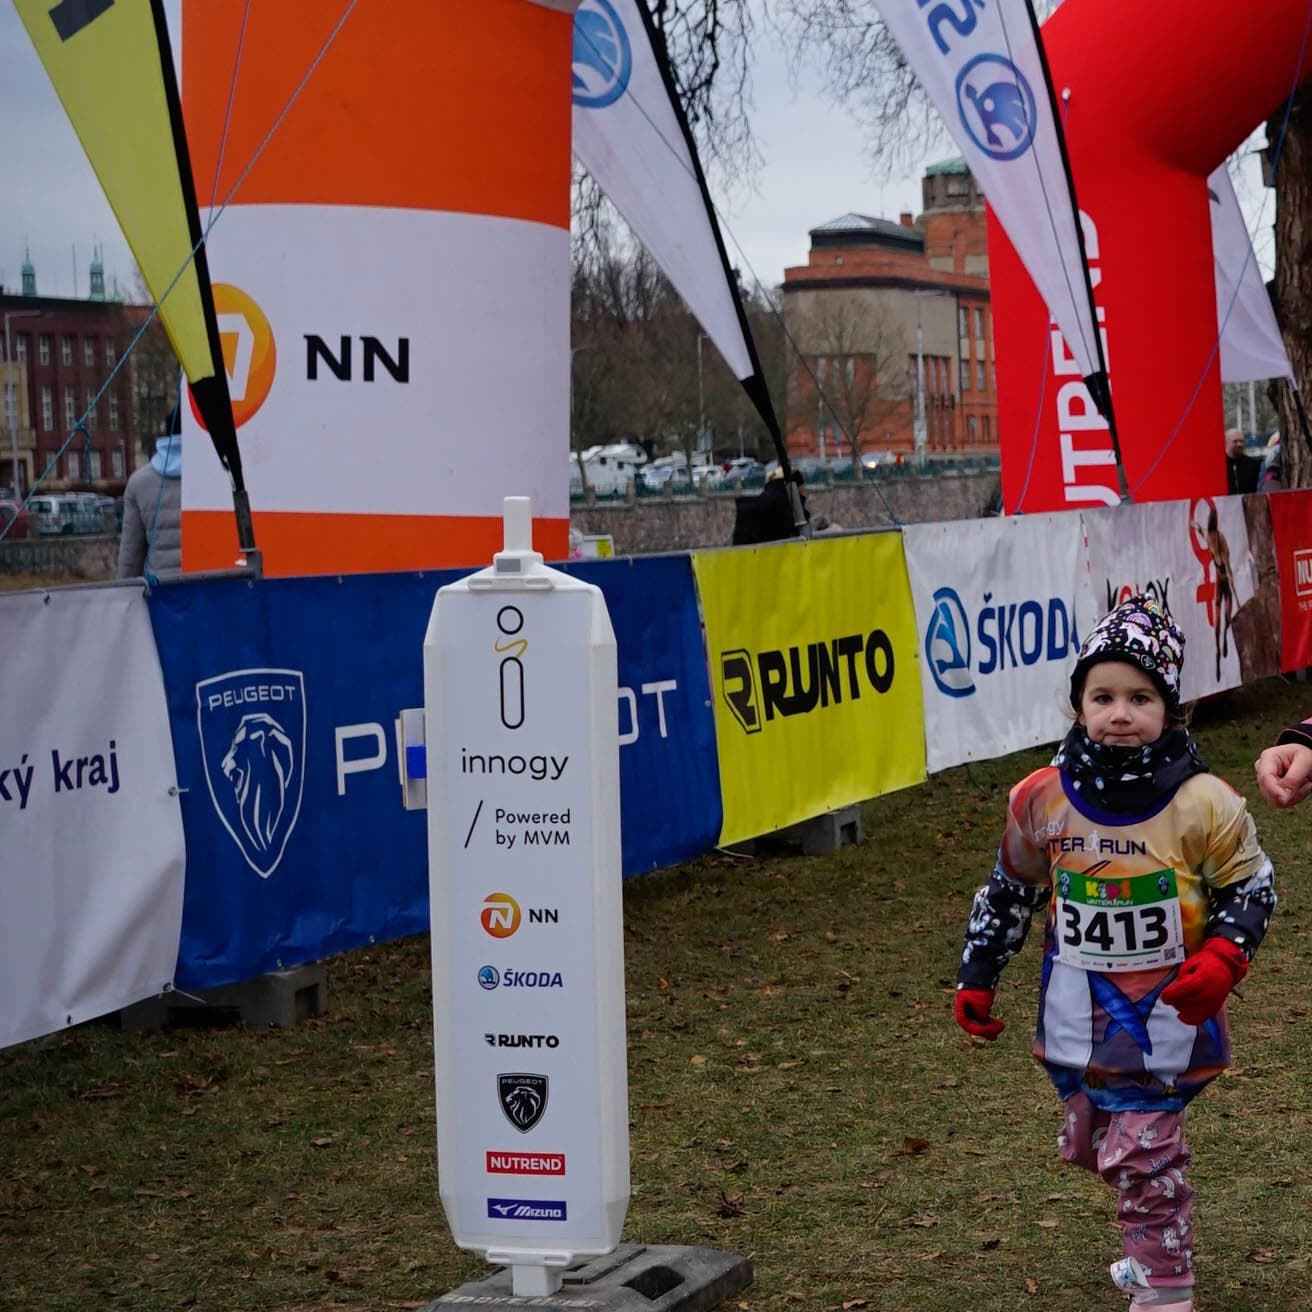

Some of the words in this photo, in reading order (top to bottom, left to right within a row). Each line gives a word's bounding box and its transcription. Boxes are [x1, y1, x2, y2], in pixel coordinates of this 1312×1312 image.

[303, 334, 409, 384] NN
[757, 629, 895, 721] RUNTO
[208, 685, 296, 712] PEUGEOT
[51, 740, 120, 794] kraj
[461, 748, 569, 780] innogy
[495, 808, 571, 824] Powered
[495, 829, 517, 849] by
[524, 830, 570, 845] MVM
[1099, 838, 1147, 856] RUN
[529, 908, 559, 924] NN
[1062, 903, 1169, 952] 3413
[502, 968, 564, 988] ŠKODA
[498, 1034, 560, 1049] RUNTO
[490, 1156, 562, 1171] NUTREND
